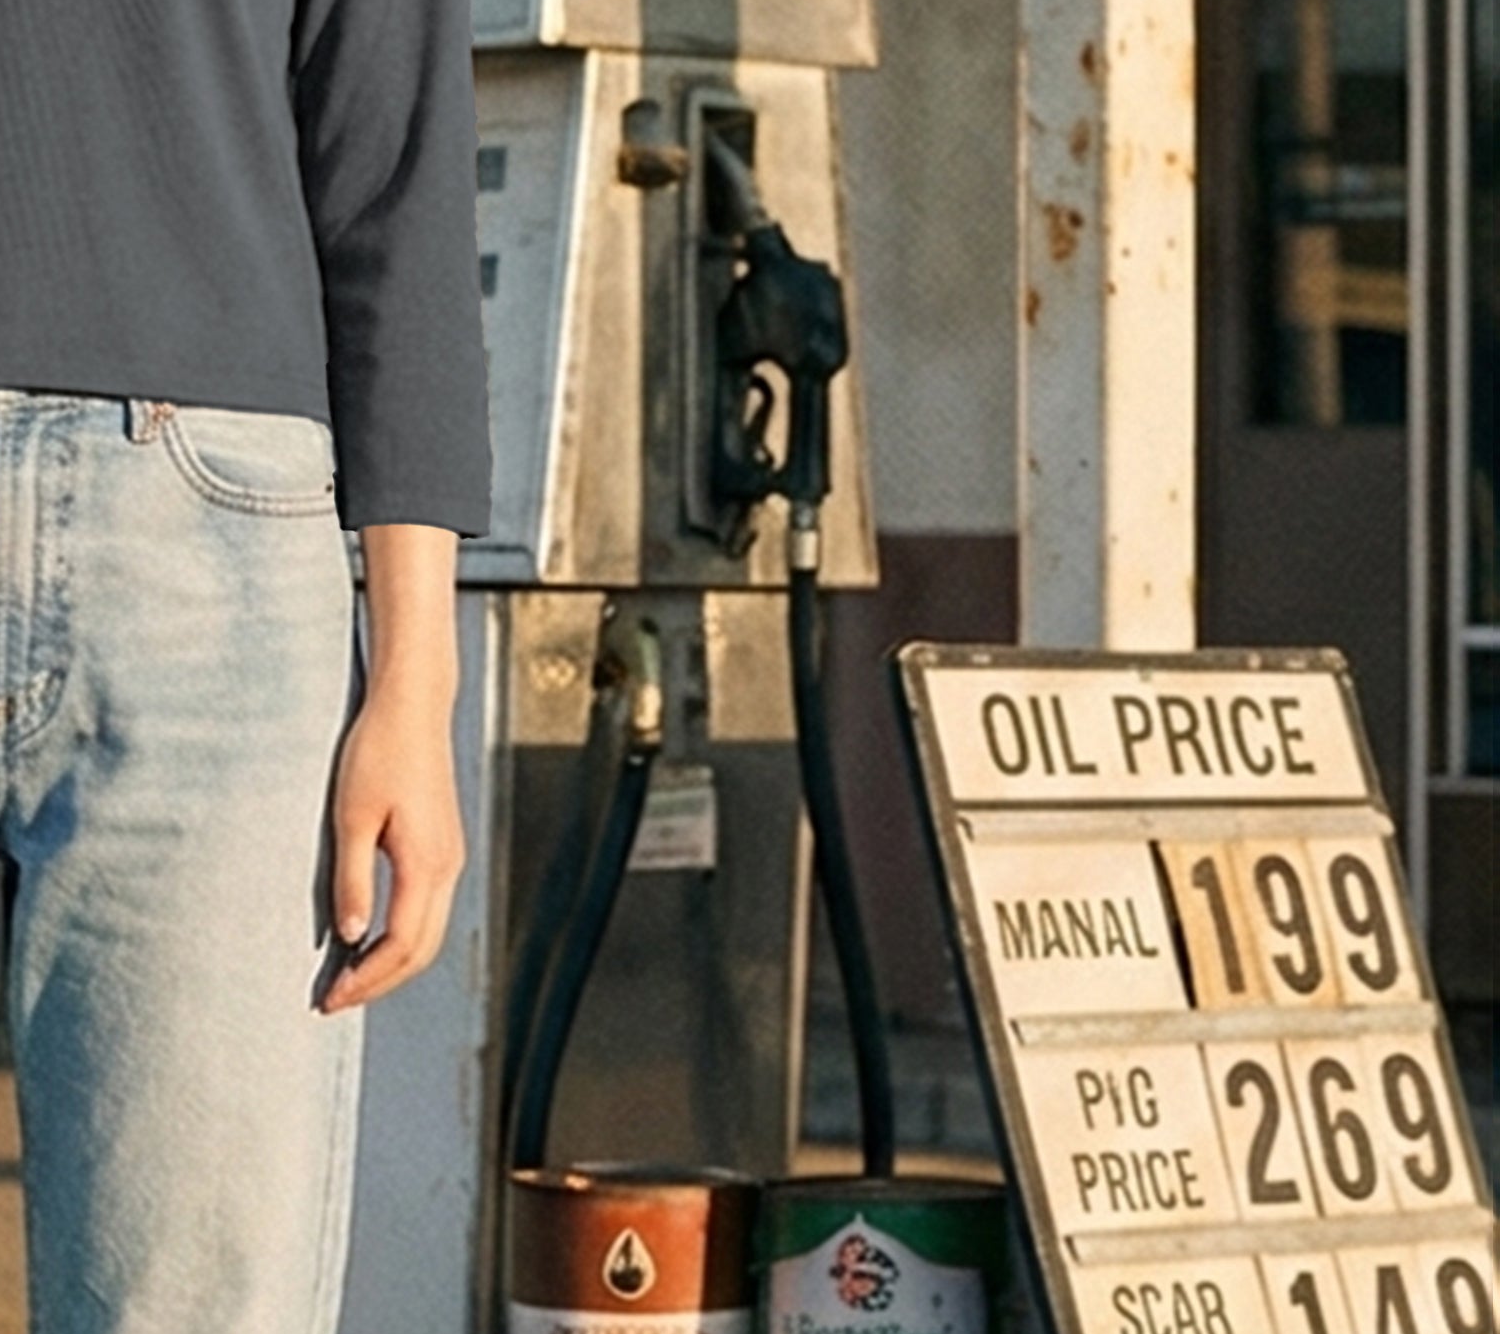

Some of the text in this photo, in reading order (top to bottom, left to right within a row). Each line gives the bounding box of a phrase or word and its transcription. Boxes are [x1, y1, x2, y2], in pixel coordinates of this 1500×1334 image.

[981, 692, 1316, 777] OIL PRICE
[993, 851, 1400, 995] MANAL 199
[1072, 1149, 1206, 1214] PRICE
[1225, 1052, 1452, 1205] 269
